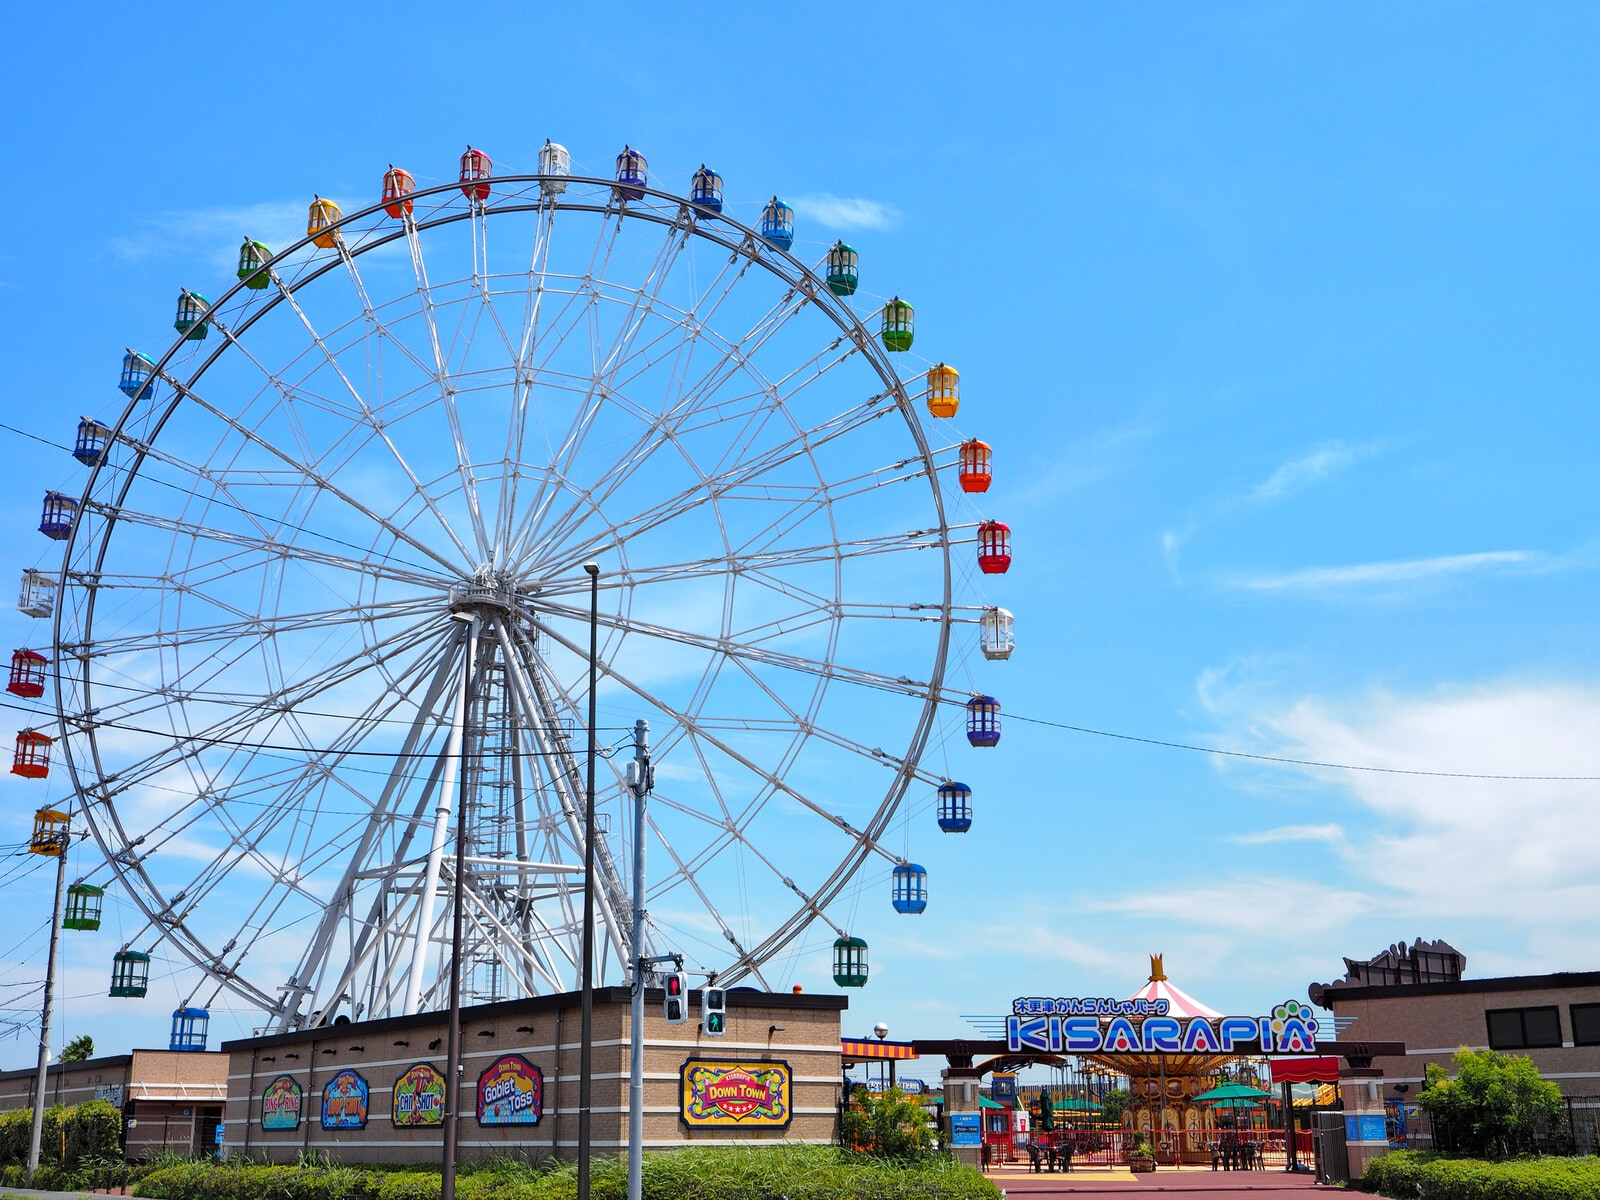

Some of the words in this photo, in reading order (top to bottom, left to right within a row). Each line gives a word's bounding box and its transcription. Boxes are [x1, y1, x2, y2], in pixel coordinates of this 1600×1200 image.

[1007, 1016, 1315, 1052] KISARAPIA
[485, 1077, 515, 1103] Goblet
[709, 1086, 738, 1100] DOWN
[739, 1084, 766, 1101] TOWN
[417, 1093, 435, 1110] SHOT
